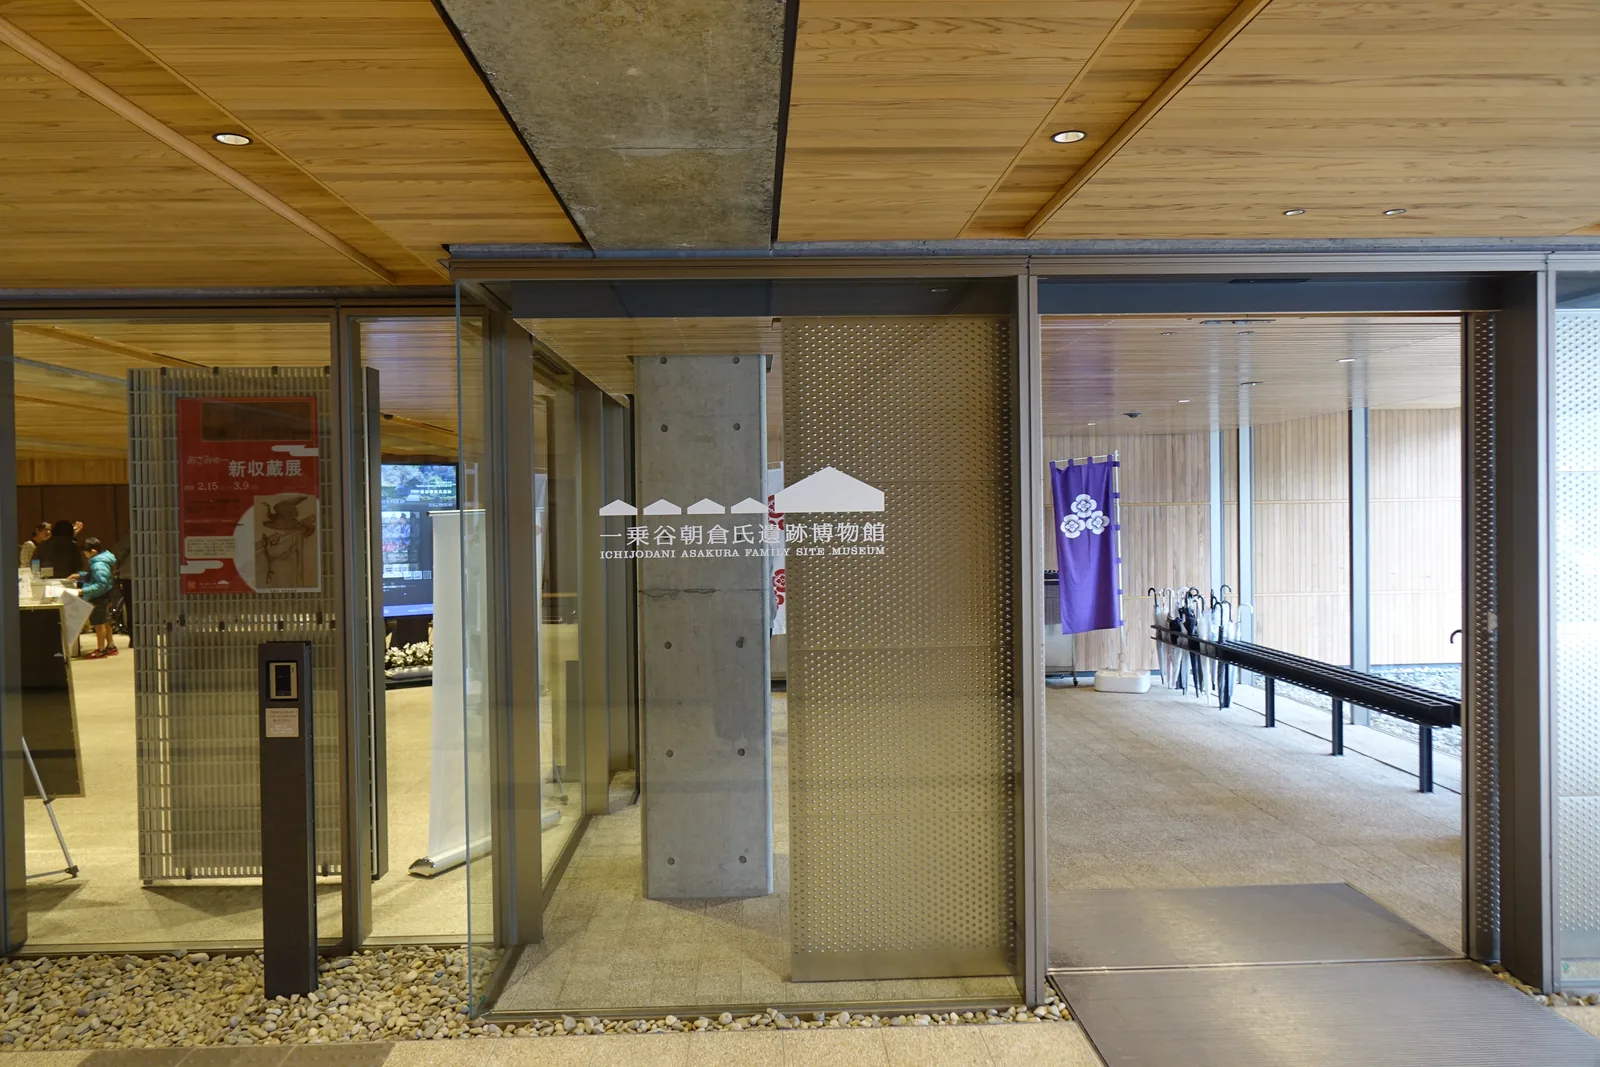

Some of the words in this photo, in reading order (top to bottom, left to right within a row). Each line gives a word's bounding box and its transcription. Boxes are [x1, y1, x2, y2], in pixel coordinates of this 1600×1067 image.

[228, 459, 302, 477] 新収蔵展
[197, 481, 218, 491] 2.15
[233, 481, 249, 491] 3.9
[600, 522, 885, 546] 一乗谷朝倉氏遺跡博物館
[600, 549, 676, 559] ICHIJODANI
[680, 548, 740, 558] ASAKURA
[745, 547, 791, 557] FAMILY
[796, 547, 825, 556] SITE
[832, 546, 885, 556] MUSEUM
